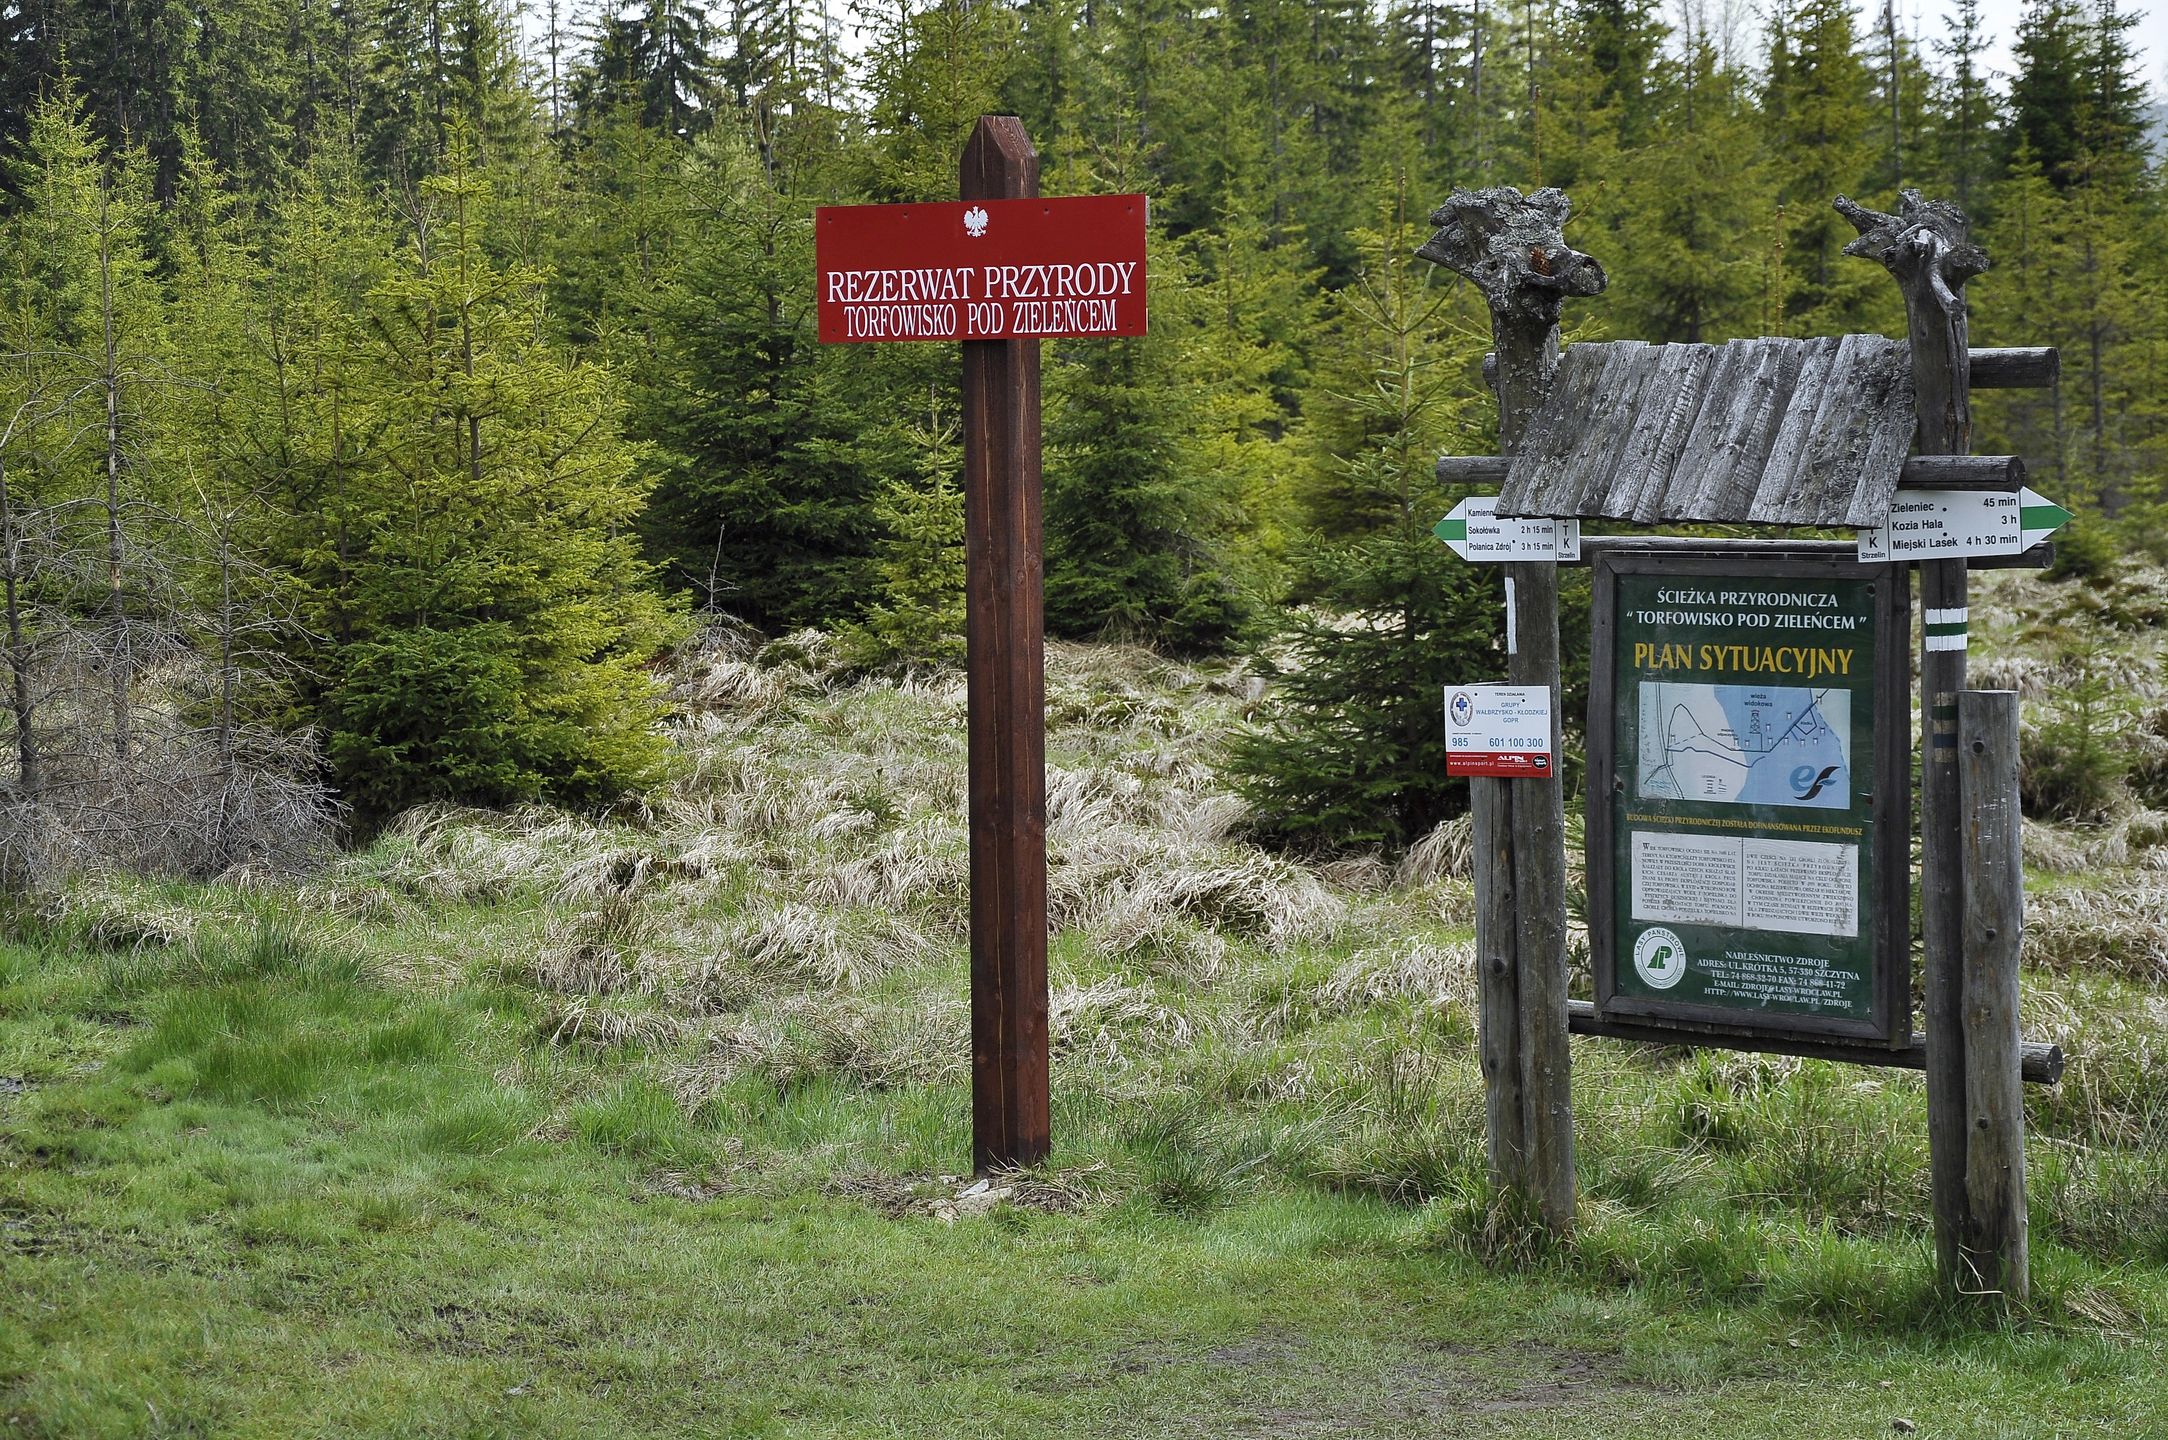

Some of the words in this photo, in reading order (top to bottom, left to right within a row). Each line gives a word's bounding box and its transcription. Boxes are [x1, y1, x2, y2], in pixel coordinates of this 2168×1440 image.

[827, 268, 974, 302] REZERWAT
[984, 261, 1136, 298] PRZYRODY
[843, 303, 957, 337] TORFOWISKO
[968, 302, 1004, 335] POD
[1012, 297, 1117, 334] ZIELEŃCEM
[1467, 508, 1494, 517] Kamienn
[1891, 503, 1934, 513] Zieleniec
[1984, 498, 1995, 507] 45
[1998, 497, 2016, 506] min
[1468, 526, 1500, 534] Sokołówka
[1892, 521, 1919, 531] Kozia
[1922, 520, 1943, 529] Hala
[2001, 516, 2008, 525] 3
[2011, 515, 2016, 524] h
[1469, 542, 1494, 551] Polanica
[1496, 542, 1512, 552] Zdrój
[1527, 542, 1531, 550] h
[1542, 542, 1553, 550] min
[1892, 540, 1926, 551] Miejski
[1929, 538, 1958, 548] Lasek
[1966, 537, 1972, 545] 4
[1975, 536, 1981, 545] h
[1985, 536, 1996, 545] 30
[2000, 534, 2017, 544] min
[1657, 587, 1715, 605] ŚCIEŻKA
[1720, 591, 1838, 607] PRZYRODNICZA
[1637, 611, 1733, 626] TORFOWISKO
[1738, 613, 1770, 627] POD
[1774, 612, 1854, 630] ZIELEŃCEM
[1635, 643, 1691, 670] PLAN
[1700, 644, 1853, 679] SYTUACYJNY
[1452, 738, 1468, 746] 985
[1489, 738, 1504, 747] 601
[1509, 738, 1524, 747] 100
[1527, 738, 1543, 747] 300
[1748, 822, 1802, 832] DOFINANSOWANA
[1802, 824, 1821, 833] PRZEZ
[1822, 826, 1862, 836] EKOFUNDUSZ
[1635, 936, 1645, 955] LASY
[1725, 950, 1793, 964] NADLEŚNICTWO
[1796, 957, 1830, 968] ZDROJE
[1697, 959, 1727, 969] ADRES:
[1728, 962, 1777, 973] UL.KRÓTKA
[1780, 966, 1786, 975] 5,
[1788, 966, 1813, 977] 57-330
[1815, 969, 1860, 980] SZCZYTNA
[1711, 970, 1729, 979] TEL:
[1778, 976, 1797, 986] FAX:
[1799, 978, 1808, 986] 74
[1714, 979, 1740, 989] E-MAIL:
